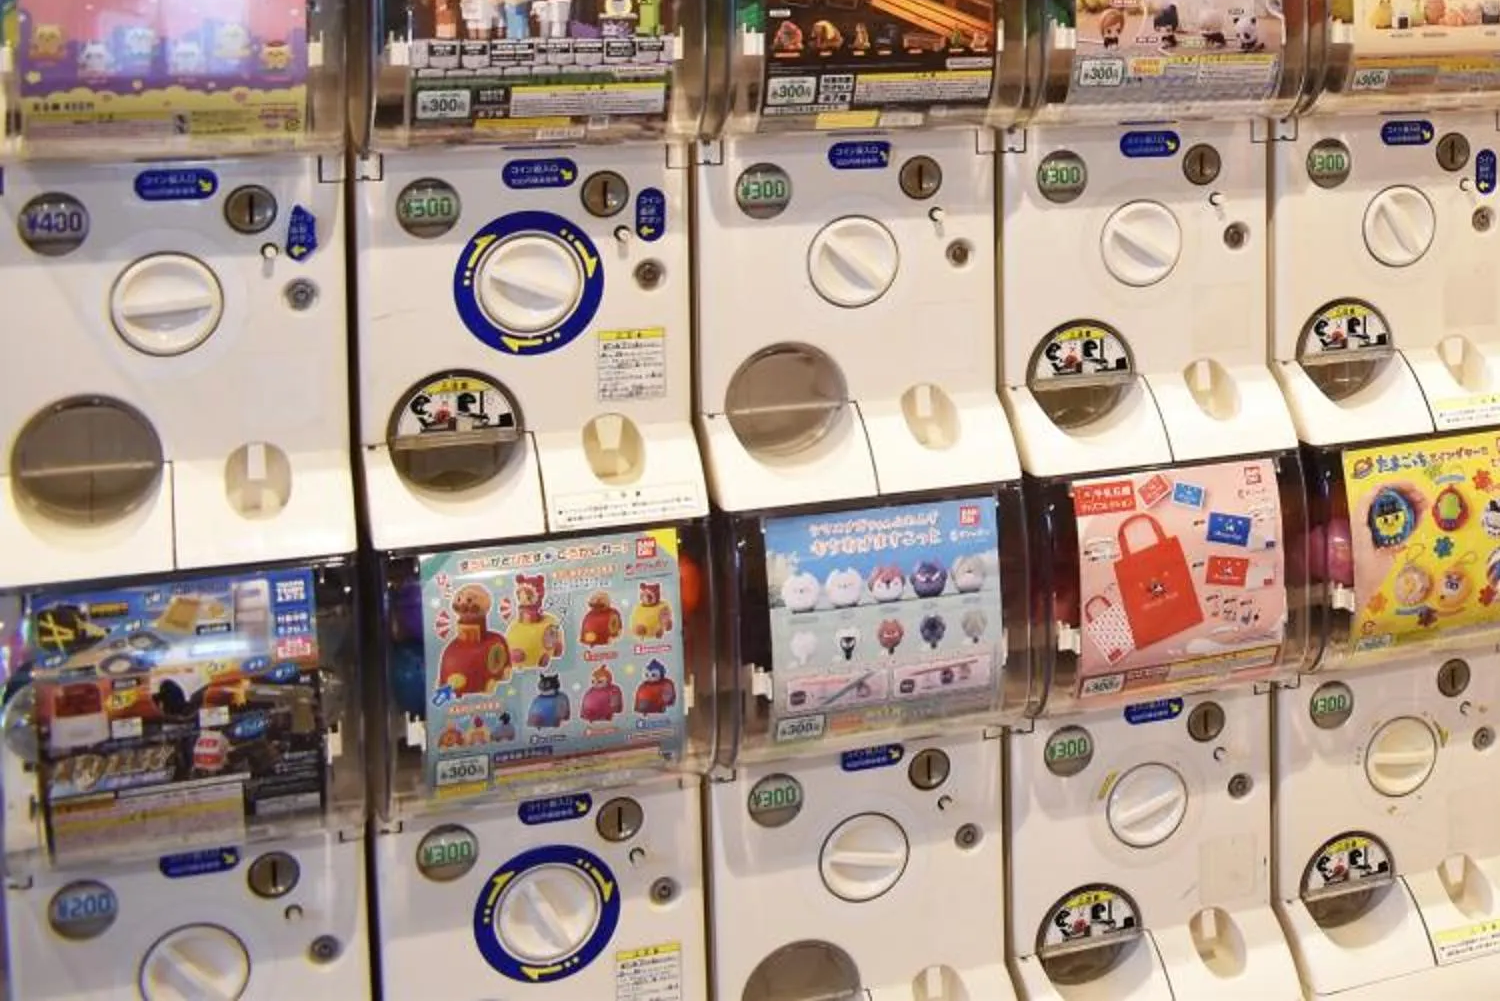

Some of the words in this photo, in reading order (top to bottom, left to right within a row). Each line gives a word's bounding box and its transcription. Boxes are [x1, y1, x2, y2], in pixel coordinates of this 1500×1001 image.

[1041, 166, 1081, 185] ¥300
[742, 180, 786, 199] ¥300
[752, 785, 797, 808] ¥300
